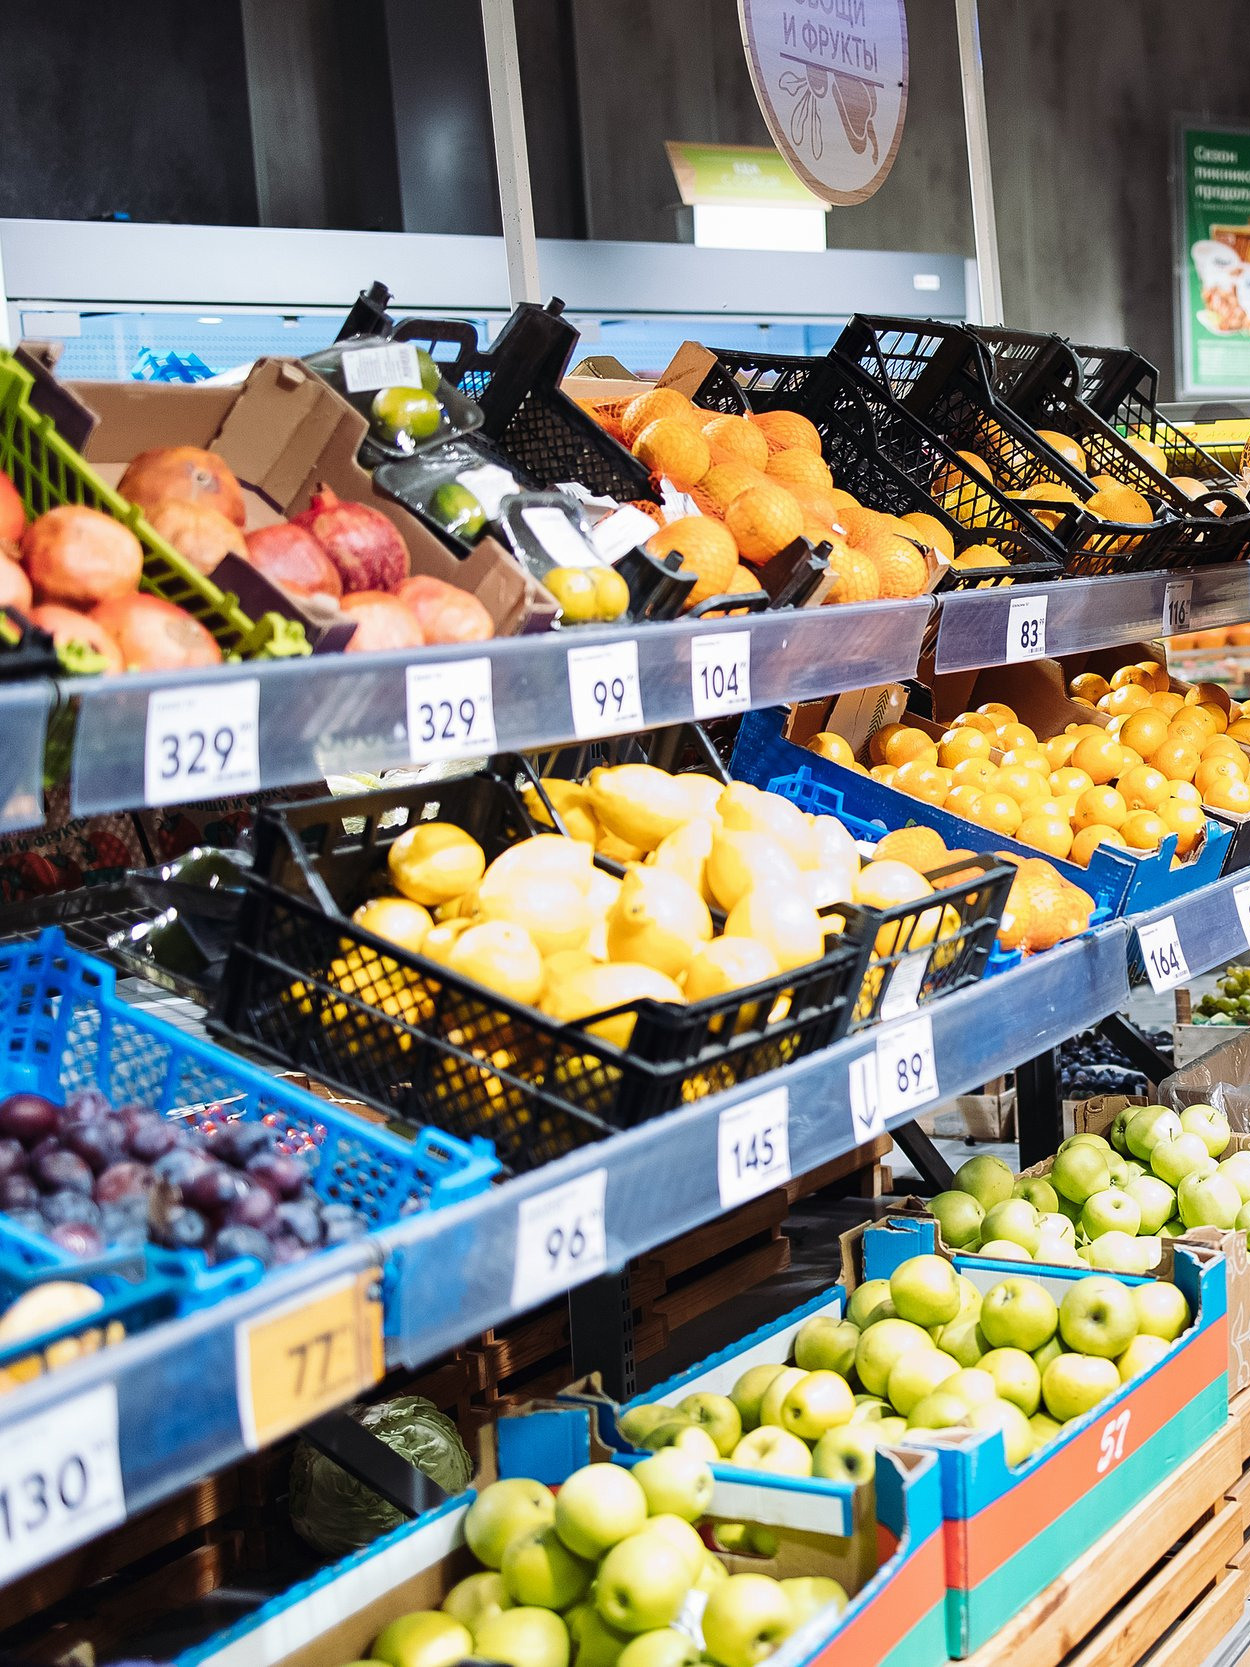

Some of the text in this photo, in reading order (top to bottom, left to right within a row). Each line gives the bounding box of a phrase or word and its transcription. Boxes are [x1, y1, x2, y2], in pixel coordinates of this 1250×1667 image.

[783, 12, 878, 73] И ФРУКТЫ
[1194, 145, 1238, 163] Сезон
[1021, 619, 1038, 648] 83
[1169, 600, 1185, 626] 116
[594, 681, 624, 717] 99
[701, 663, 738, 700] 104
[420, 698, 475, 742] 329
[162, 727, 234, 778] 329
[1151, 943, 1180, 979] 164
[897, 1053, 922, 1092] 89
[734, 1128, 774, 1178] 145
[546, 1216, 586, 1272] 96
[288, 1332, 333, 1396] 77
[1097, 1408, 1131, 1473] 57
[0, 1454, 88, 1542] 130
